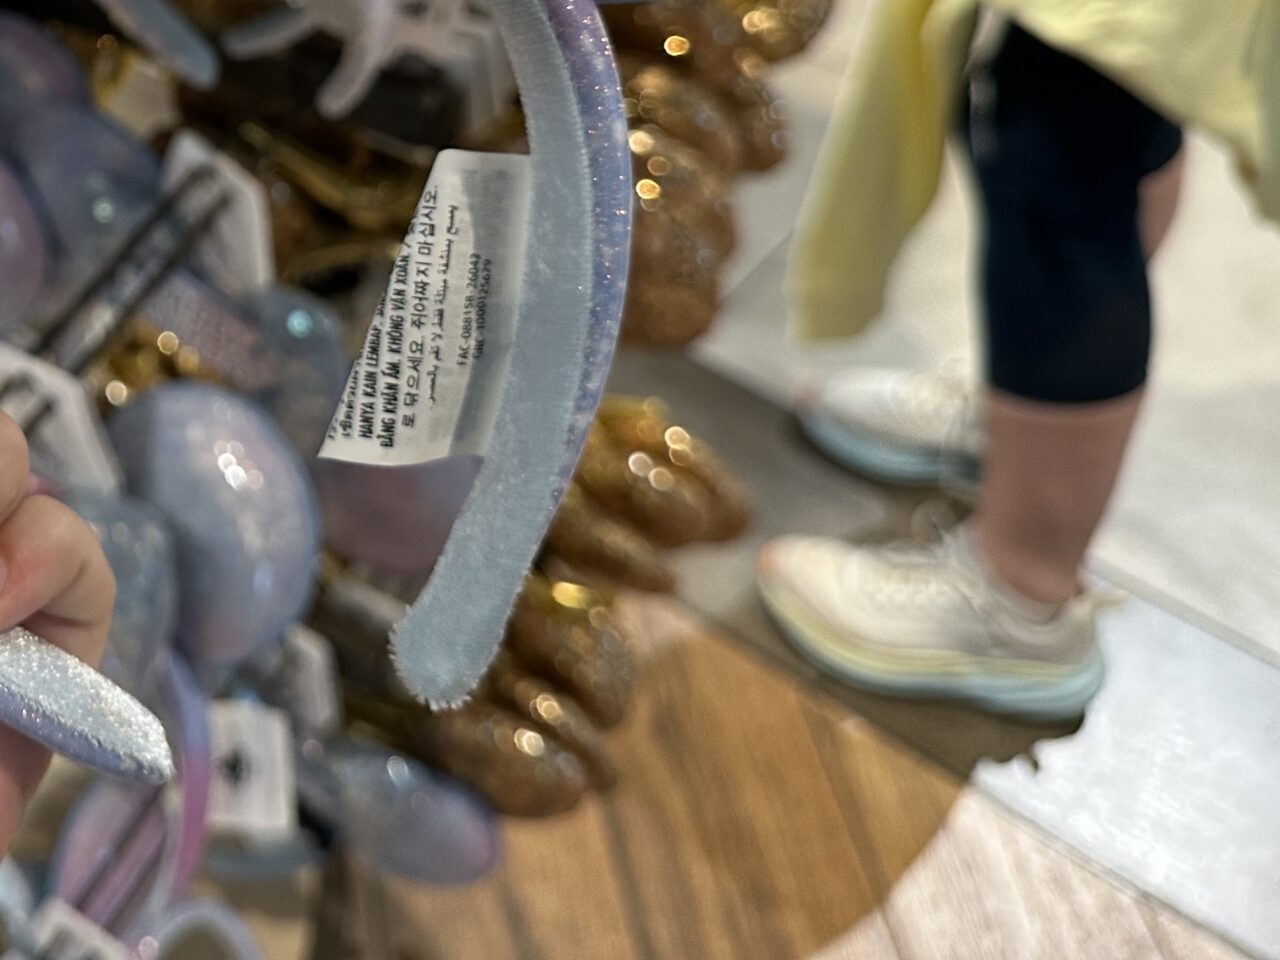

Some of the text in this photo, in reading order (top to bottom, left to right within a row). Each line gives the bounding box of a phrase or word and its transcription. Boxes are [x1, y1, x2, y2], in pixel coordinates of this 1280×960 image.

[402, 185, 438, 428] 로 닦으세요. 쥐어짜지 마십시오.
[362, 370, 378, 398] KAIN
[358, 402, 375, 438] HANYA
